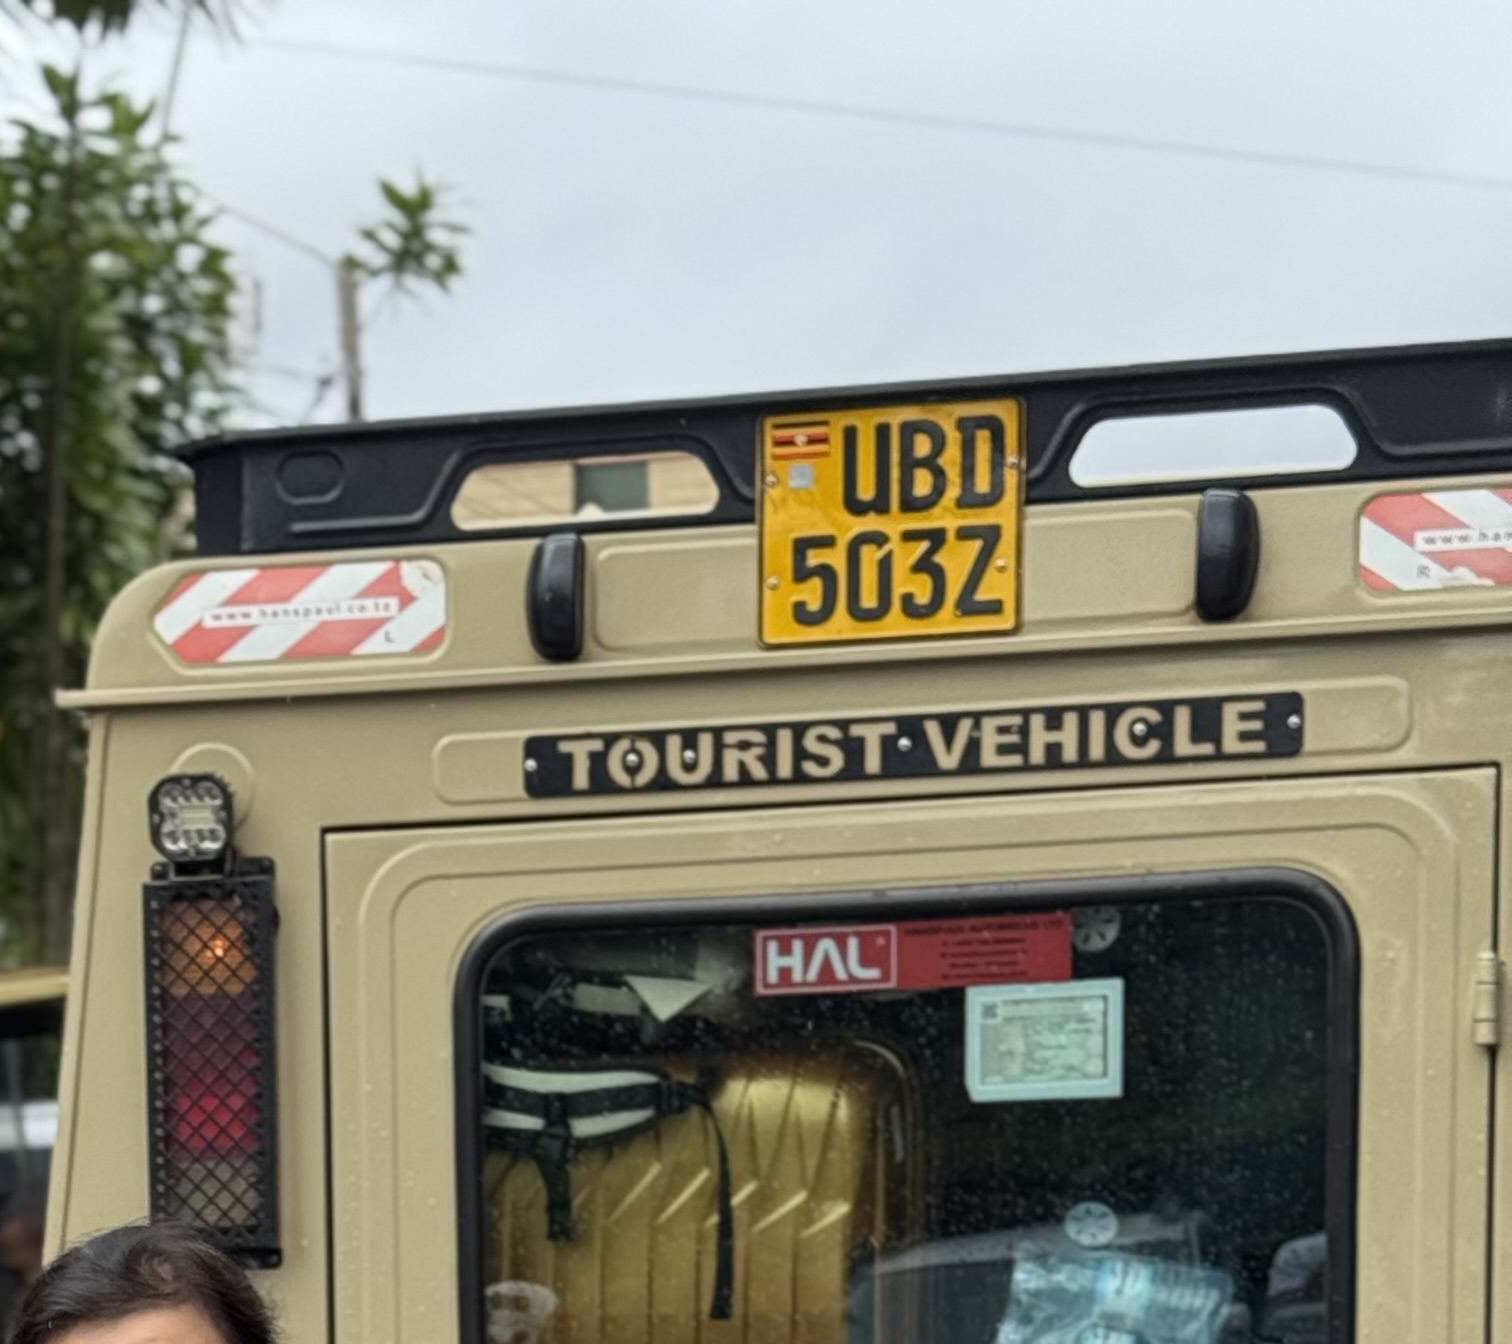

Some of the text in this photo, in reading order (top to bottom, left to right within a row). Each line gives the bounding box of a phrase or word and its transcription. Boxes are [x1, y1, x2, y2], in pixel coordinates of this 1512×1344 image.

[843, 415, 1005, 517] UBD
[792, 524, 1004, 628] 503Z
[557, 700, 1268, 791] TOURIST VEHICLE
[766, 935, 882, 985] HAL
